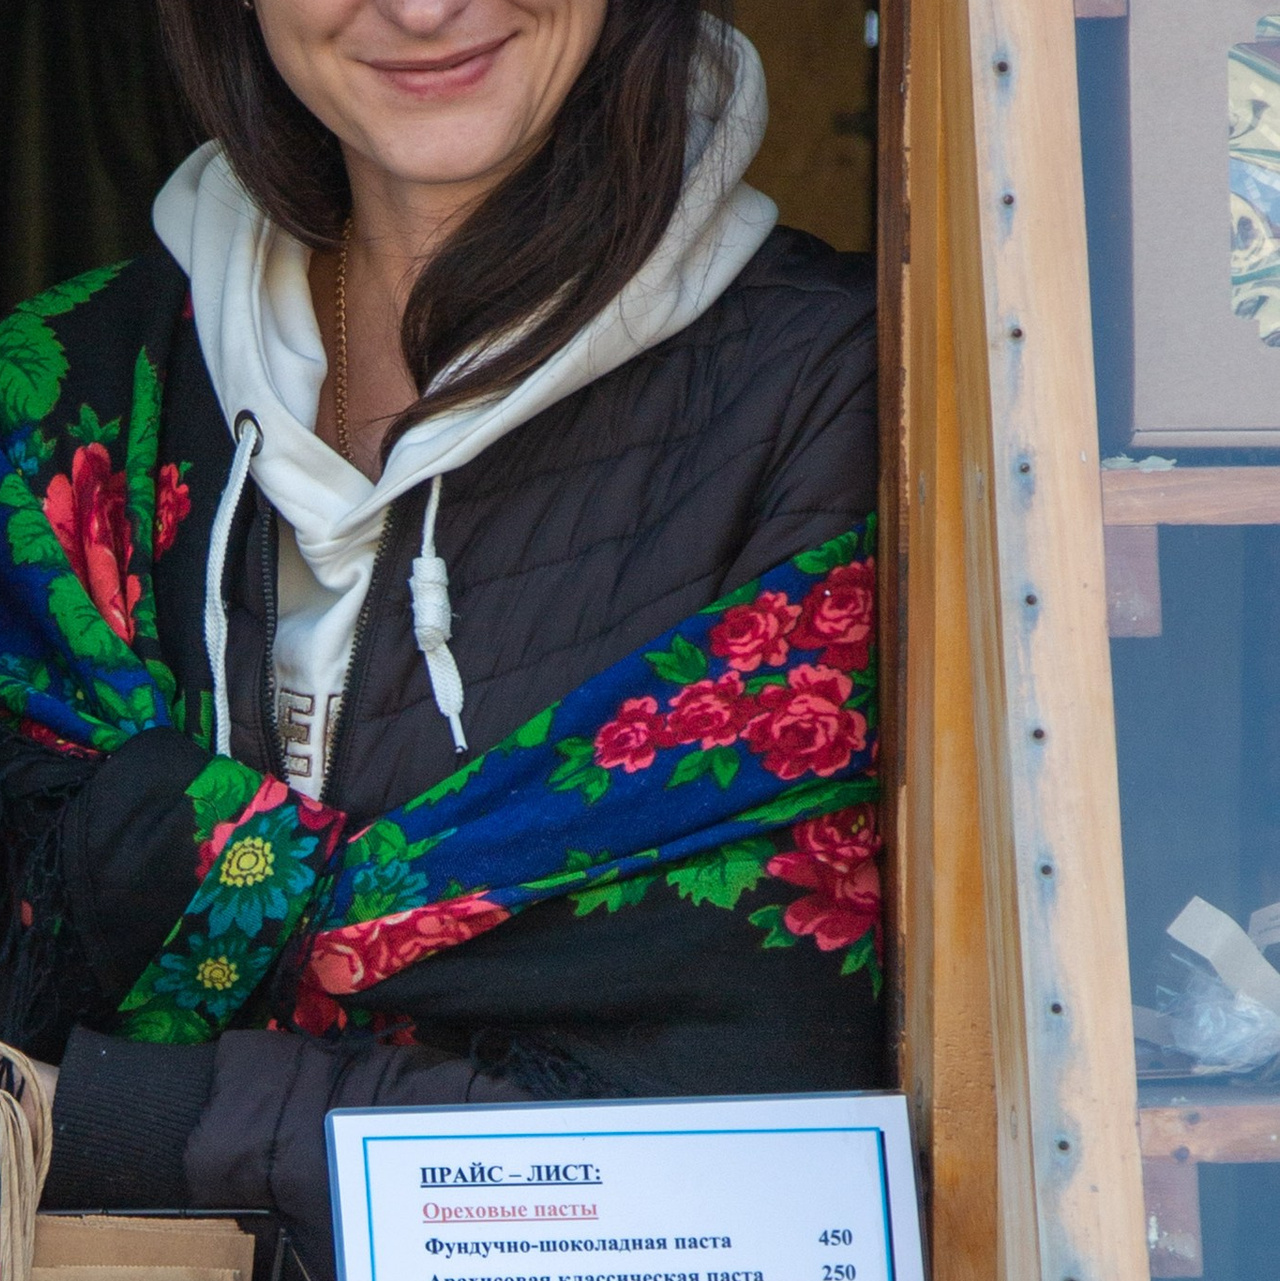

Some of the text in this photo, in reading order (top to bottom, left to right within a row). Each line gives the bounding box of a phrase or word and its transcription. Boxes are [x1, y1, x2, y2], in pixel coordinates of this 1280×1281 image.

[420, 1162, 503, 1184] ПРАЙС
[528, 1164, 602, 1184] ЛИСТ:
[422, 1200, 598, 1222] Ореховые пасты
[425, 1229, 853, 1258] Фундучно-шоколадная паста 450
[822, 1265, 856, 1281] 250
